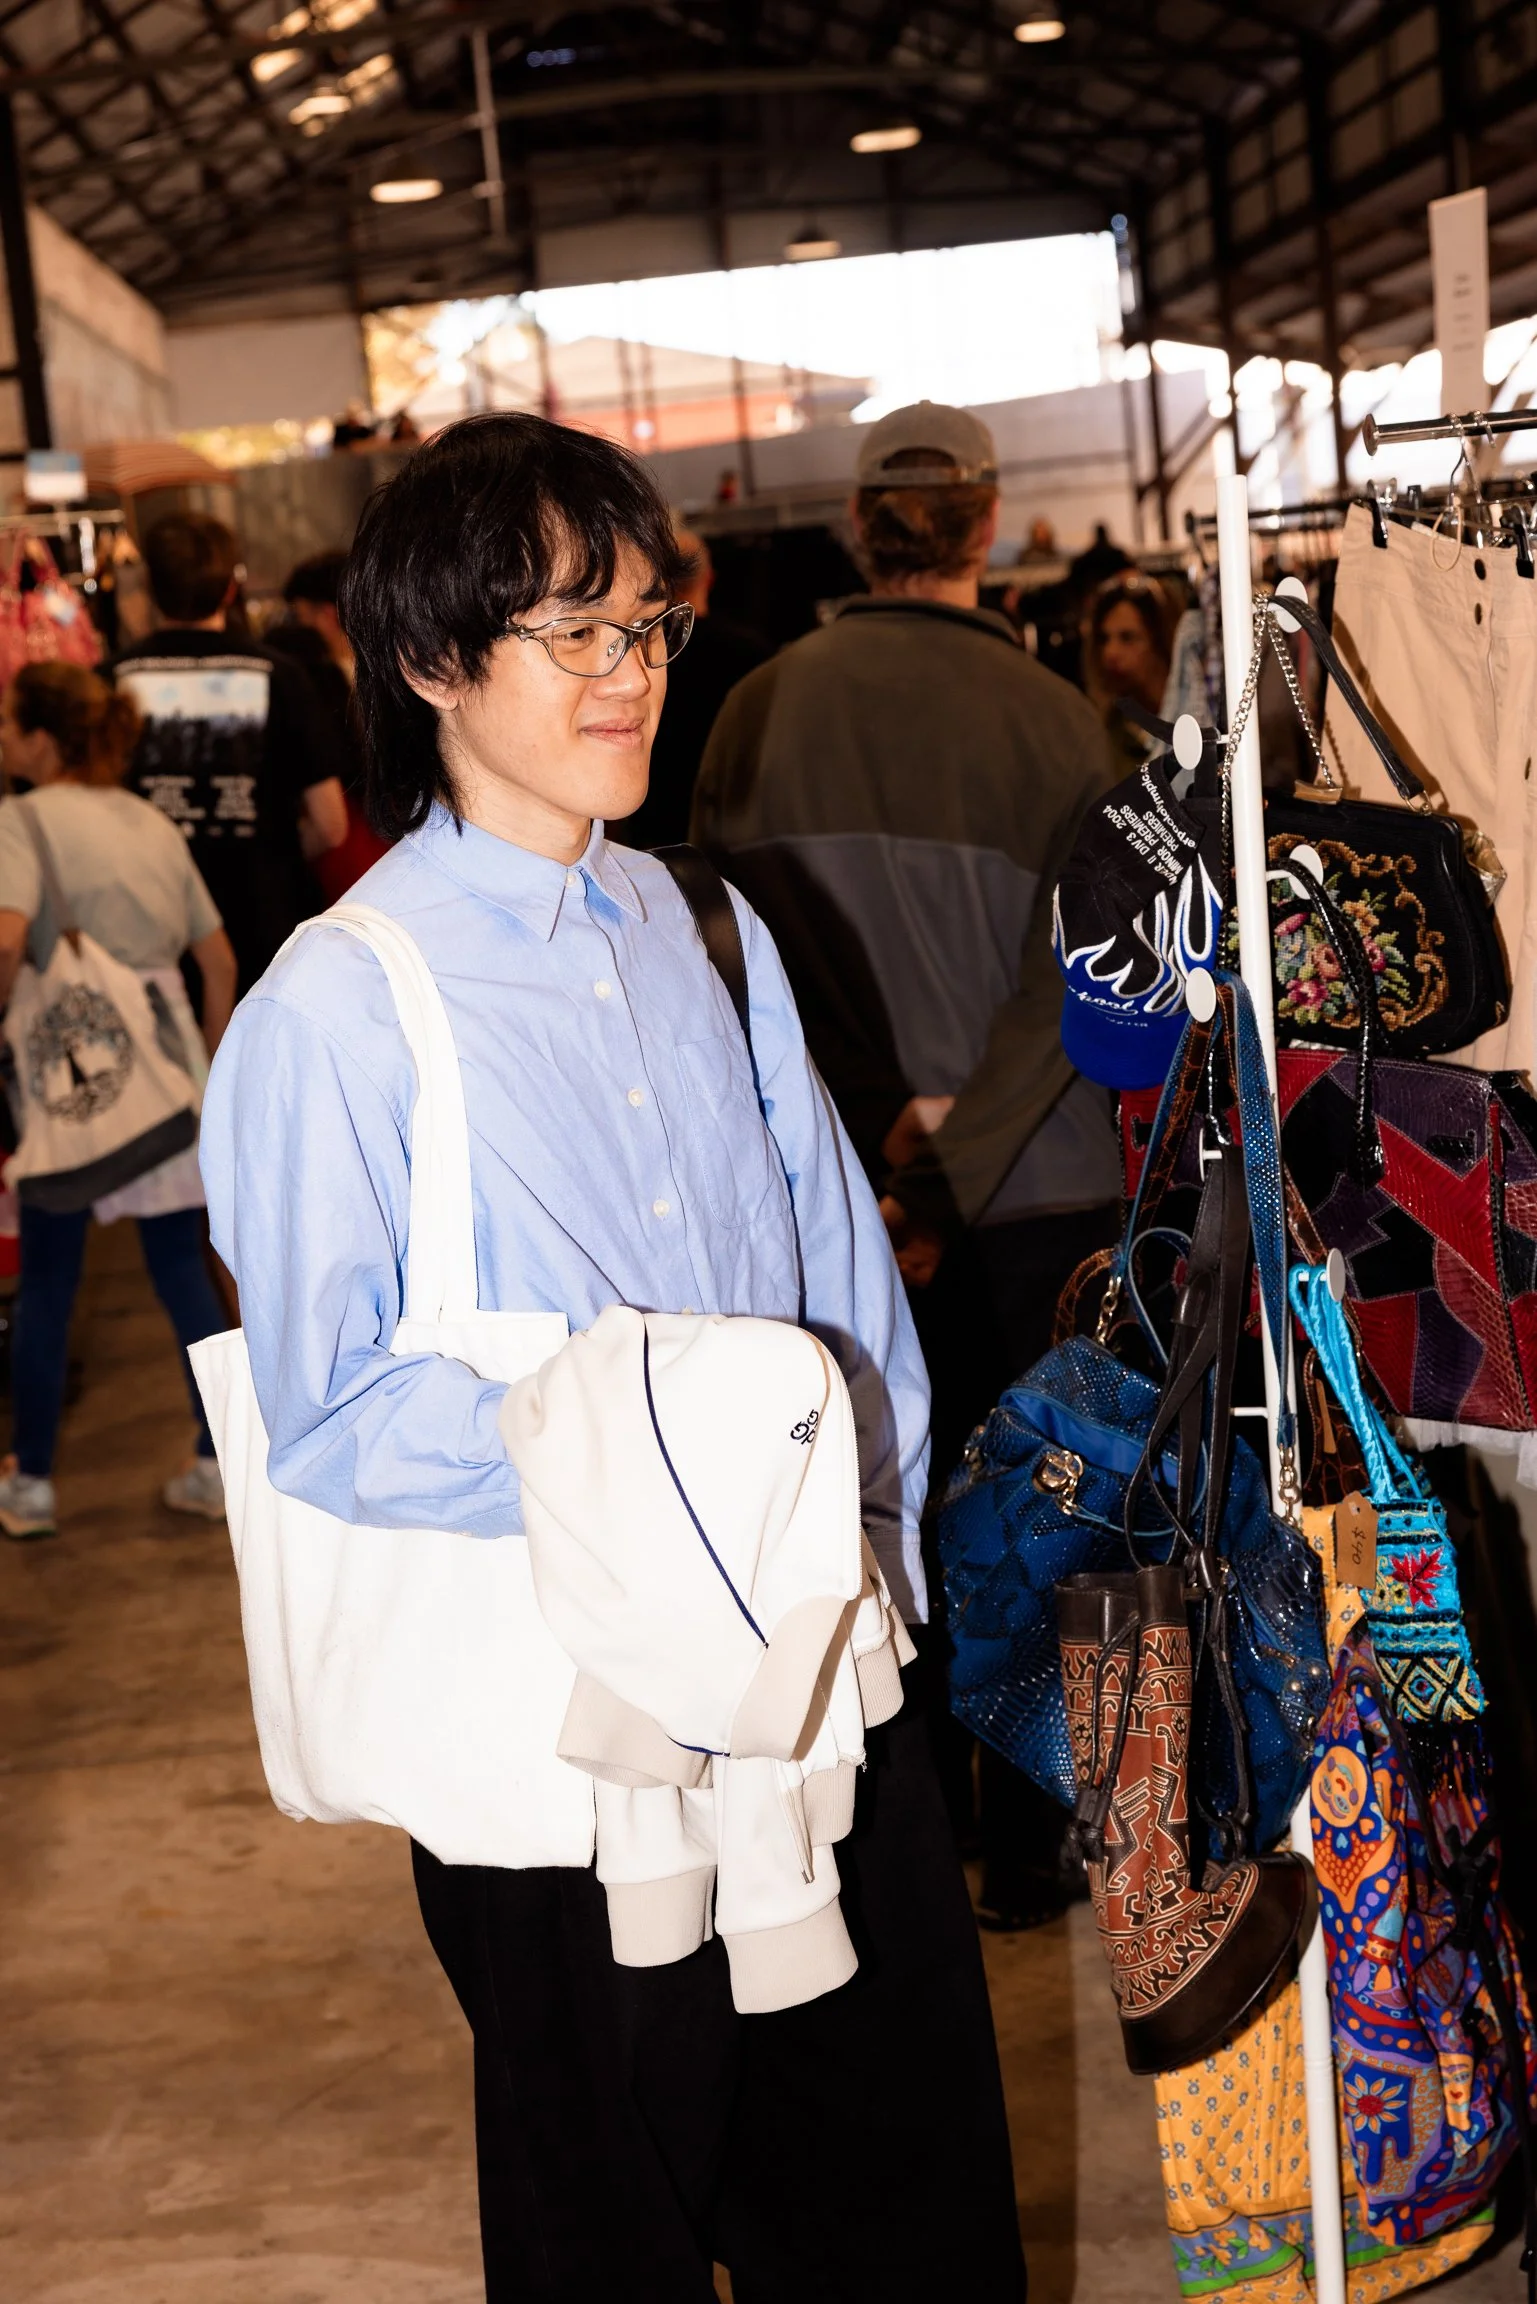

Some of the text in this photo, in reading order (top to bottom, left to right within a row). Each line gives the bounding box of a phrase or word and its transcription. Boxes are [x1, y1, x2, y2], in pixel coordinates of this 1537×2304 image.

[1102, 804, 1127, 829] 2004
[1142, 811, 1179, 852] PREMIERS
[1120, 804, 1184, 875] MINOR PREMIERS
[1154, 862, 1177, 886] NDER
[1351, 1526, 1366, 1565] $40
